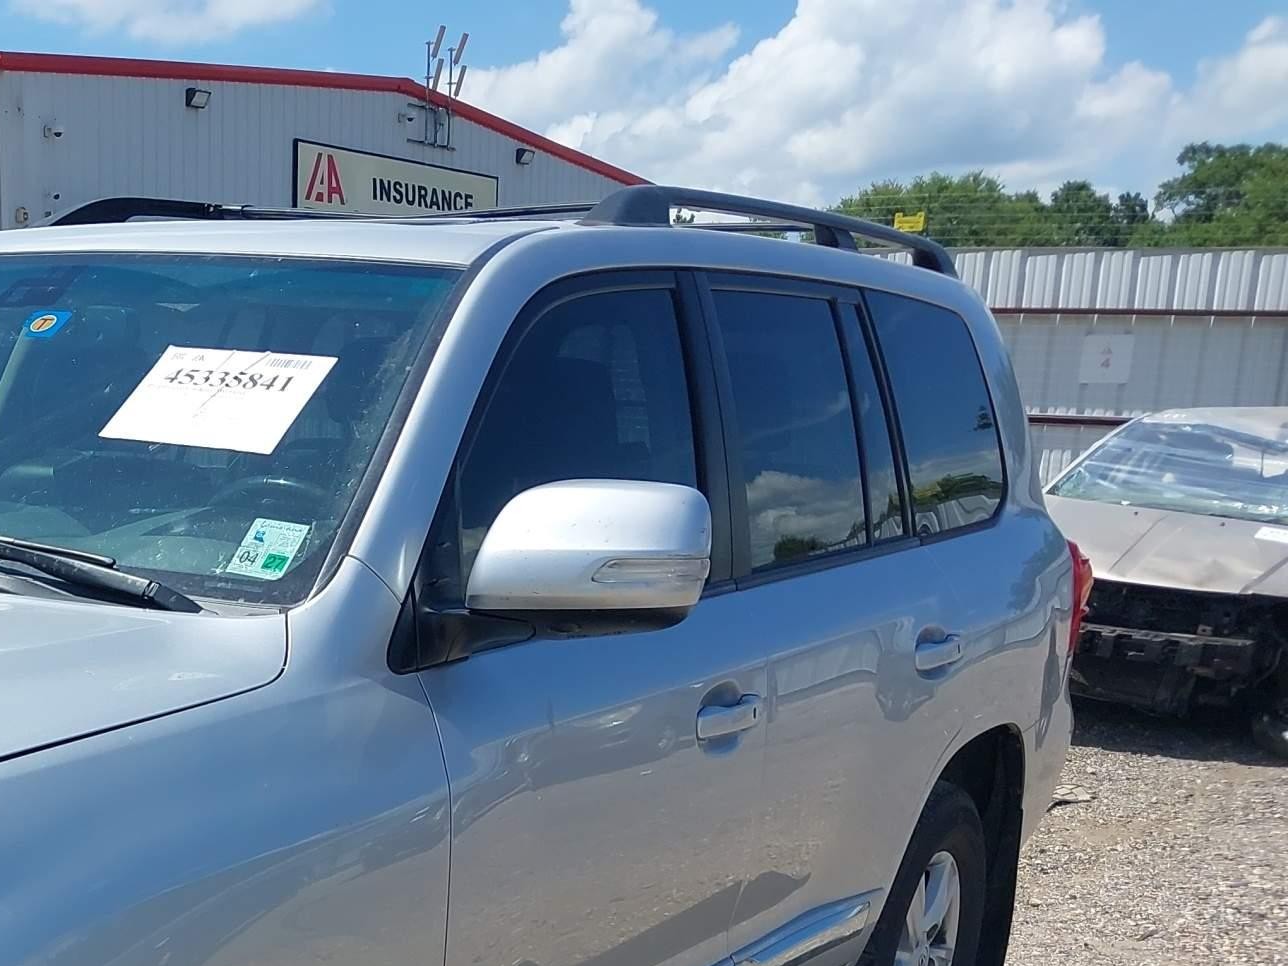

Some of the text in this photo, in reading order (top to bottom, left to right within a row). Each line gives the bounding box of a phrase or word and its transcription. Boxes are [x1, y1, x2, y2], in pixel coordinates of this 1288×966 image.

[372, 177, 474, 211] INSURANCE
[164, 368, 294, 392] 45335841
[239, 551, 259, 565] 04
[264, 555, 286, 571] 27
